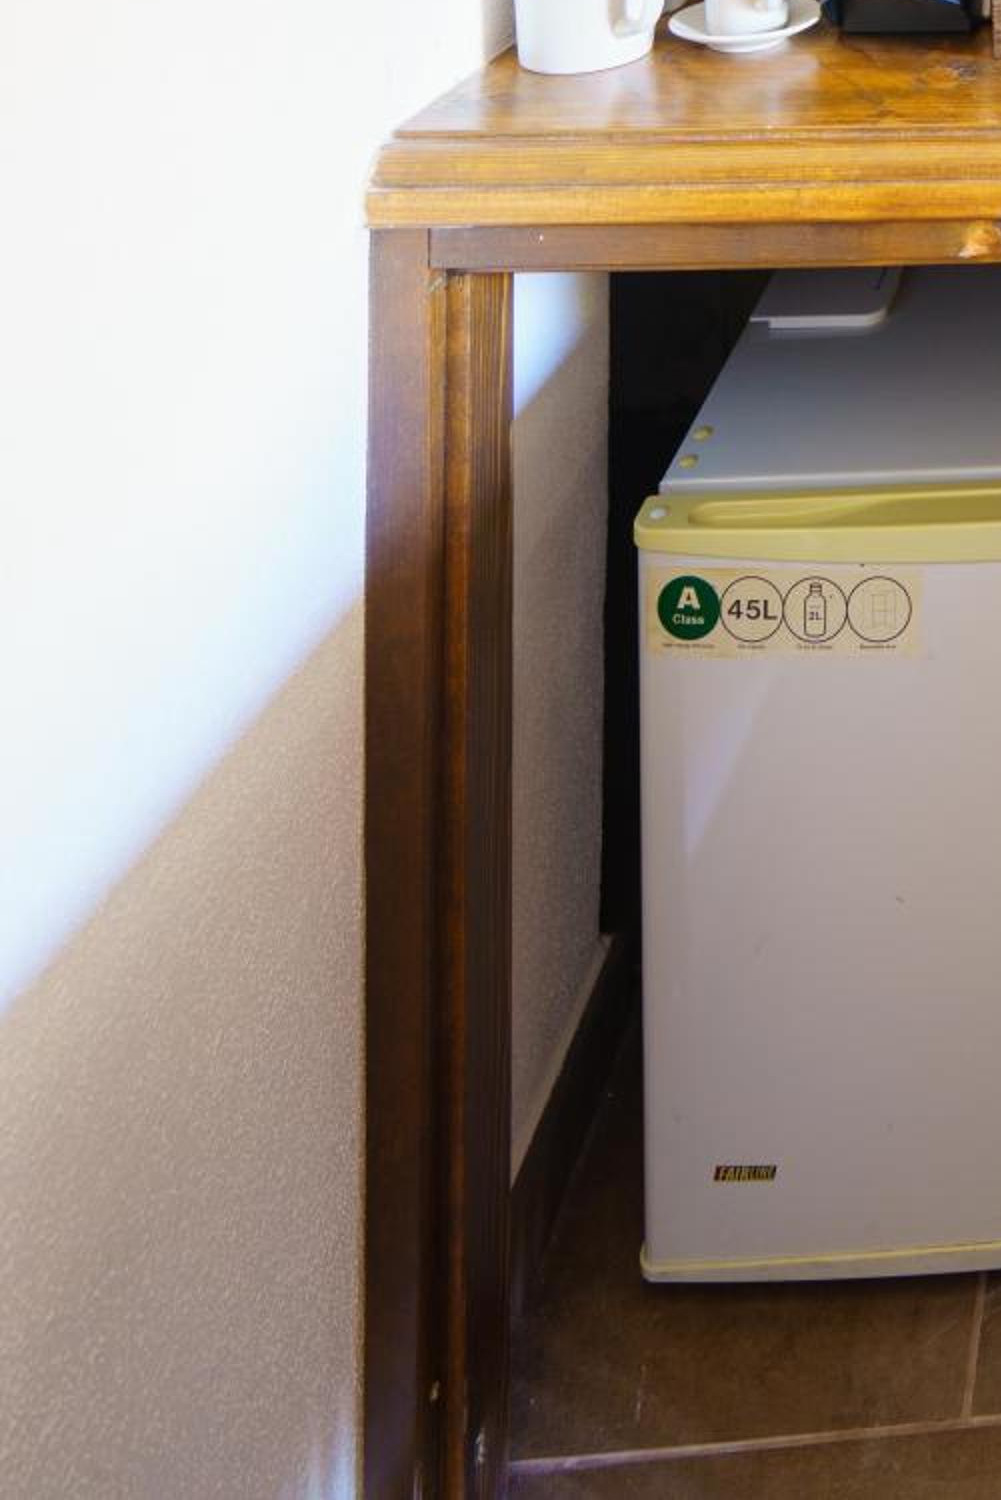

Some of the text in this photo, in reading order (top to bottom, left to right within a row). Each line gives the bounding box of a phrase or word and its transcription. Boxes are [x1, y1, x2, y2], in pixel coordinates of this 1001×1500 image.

[676, 585, 701, 609] A
[672, 613, 705, 625] Class
[727, 599, 778, 621] 45L
